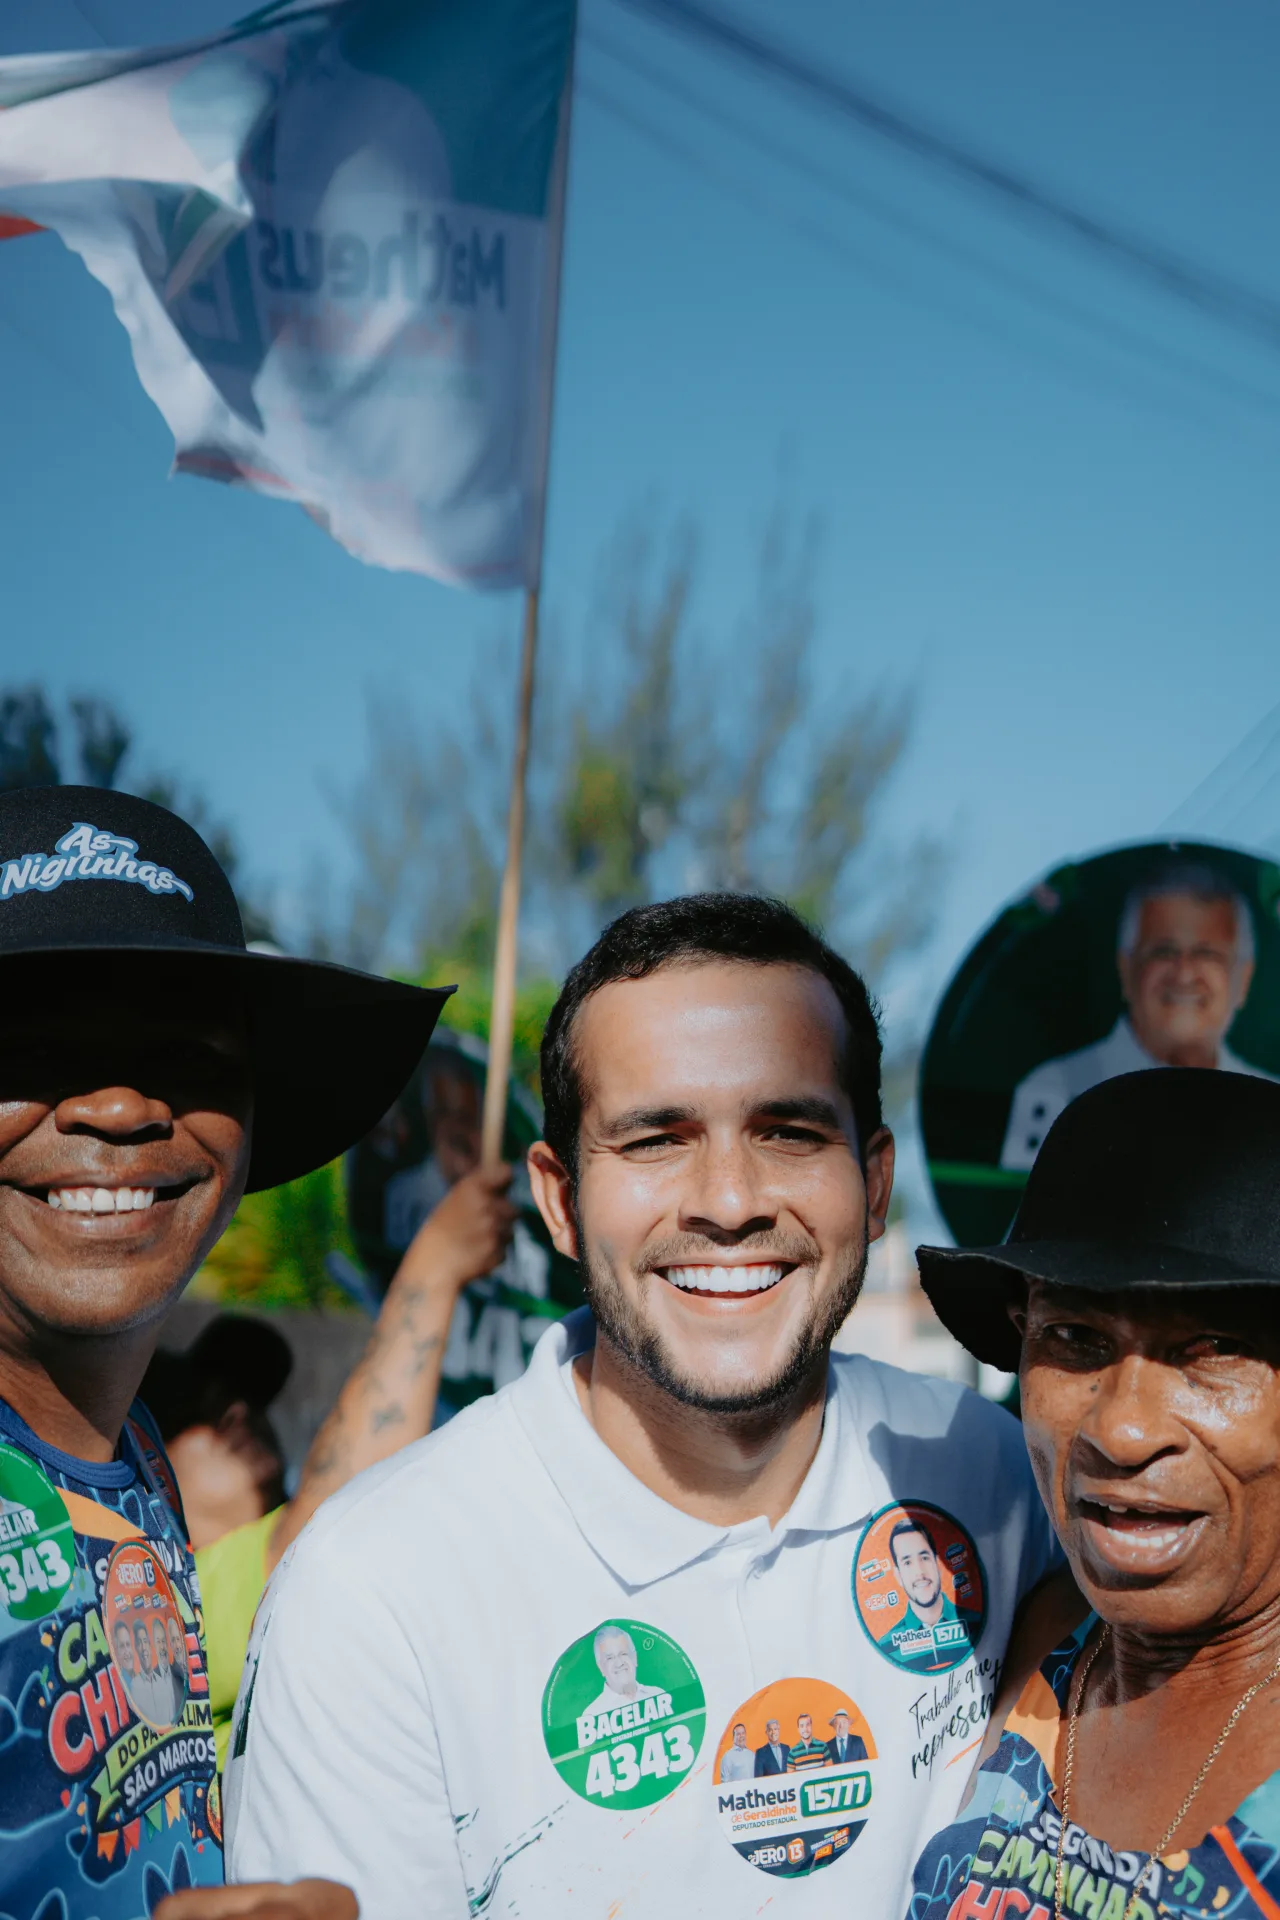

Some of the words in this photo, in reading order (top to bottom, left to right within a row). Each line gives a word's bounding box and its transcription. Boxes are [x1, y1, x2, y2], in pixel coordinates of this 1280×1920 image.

[59, 824, 135, 852] As
[1, 850, 192, 897] Nigrinhas
[0, 1509, 40, 1541] ELAR
[0, 1539, 71, 1606] 343
[144, 1562, 155, 1583] 13
[893, 1629, 932, 1645] Matheus
[965, 1658, 992, 1693] que
[118, 1737, 140, 1769] DO
[187, 1703, 213, 1727] LIM
[576, 1693, 675, 1749] BACELAR
[123, 1760, 157, 1807] SÃO
[158, 1736, 216, 1777] MARCOS
[585, 1724, 695, 1798] 4343
[718, 1788, 796, 1813] Matheus
[804, 1775, 867, 1812] 15777
[732, 1818, 766, 1832] DEPUTADO
[766, 1816, 798, 1826] ESTADUAL
[743, 1805, 797, 1821] Geraldinho
[789, 1843, 804, 1860] 13
